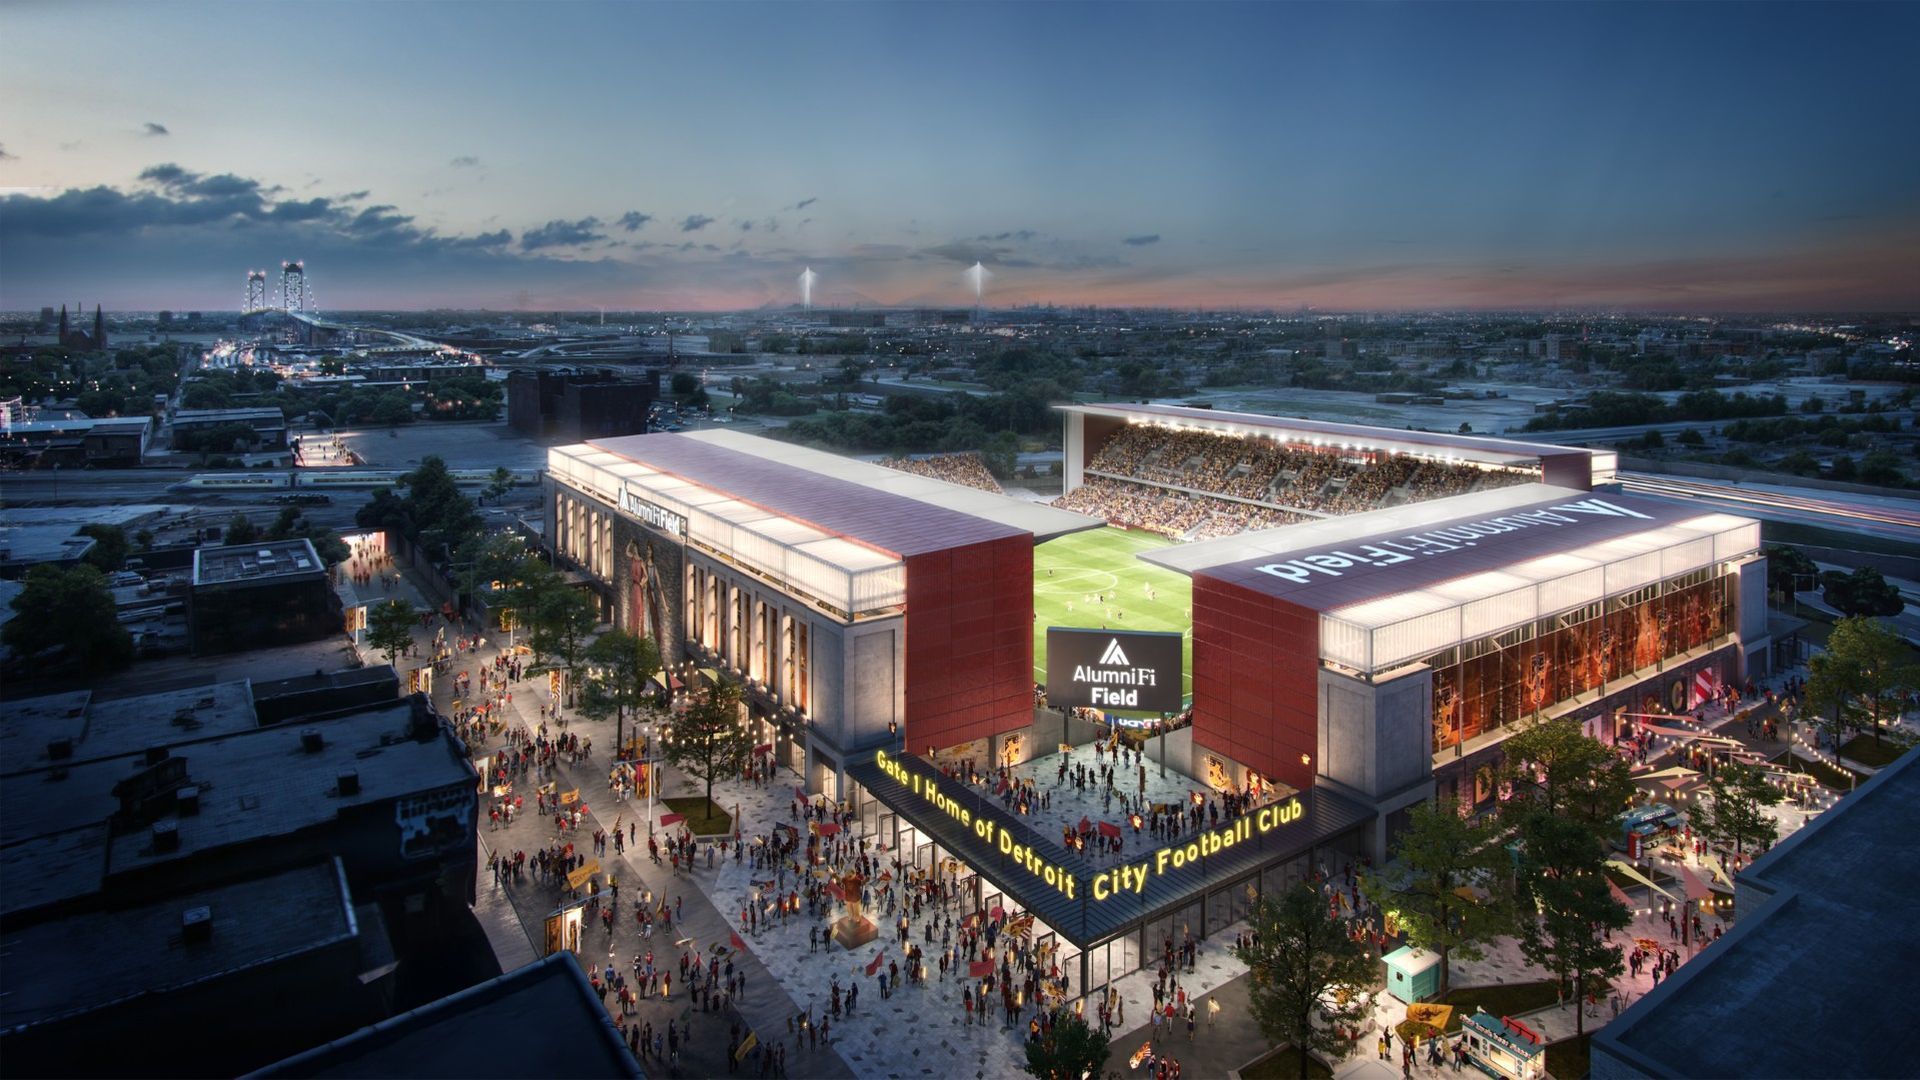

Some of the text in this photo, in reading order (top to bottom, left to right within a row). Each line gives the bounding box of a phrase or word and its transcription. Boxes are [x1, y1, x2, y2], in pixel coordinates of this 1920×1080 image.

[660, 509, 680, 536] Field
[1254, 509, 1578, 584] AlumniFi Field
[1073, 664, 1157, 687] AlumniFi
[1091, 687, 1138, 707] Field
[876, 750, 1075, 900] Gate 1 Home of Detroit
[1093, 798, 1302, 901] City Football Club
